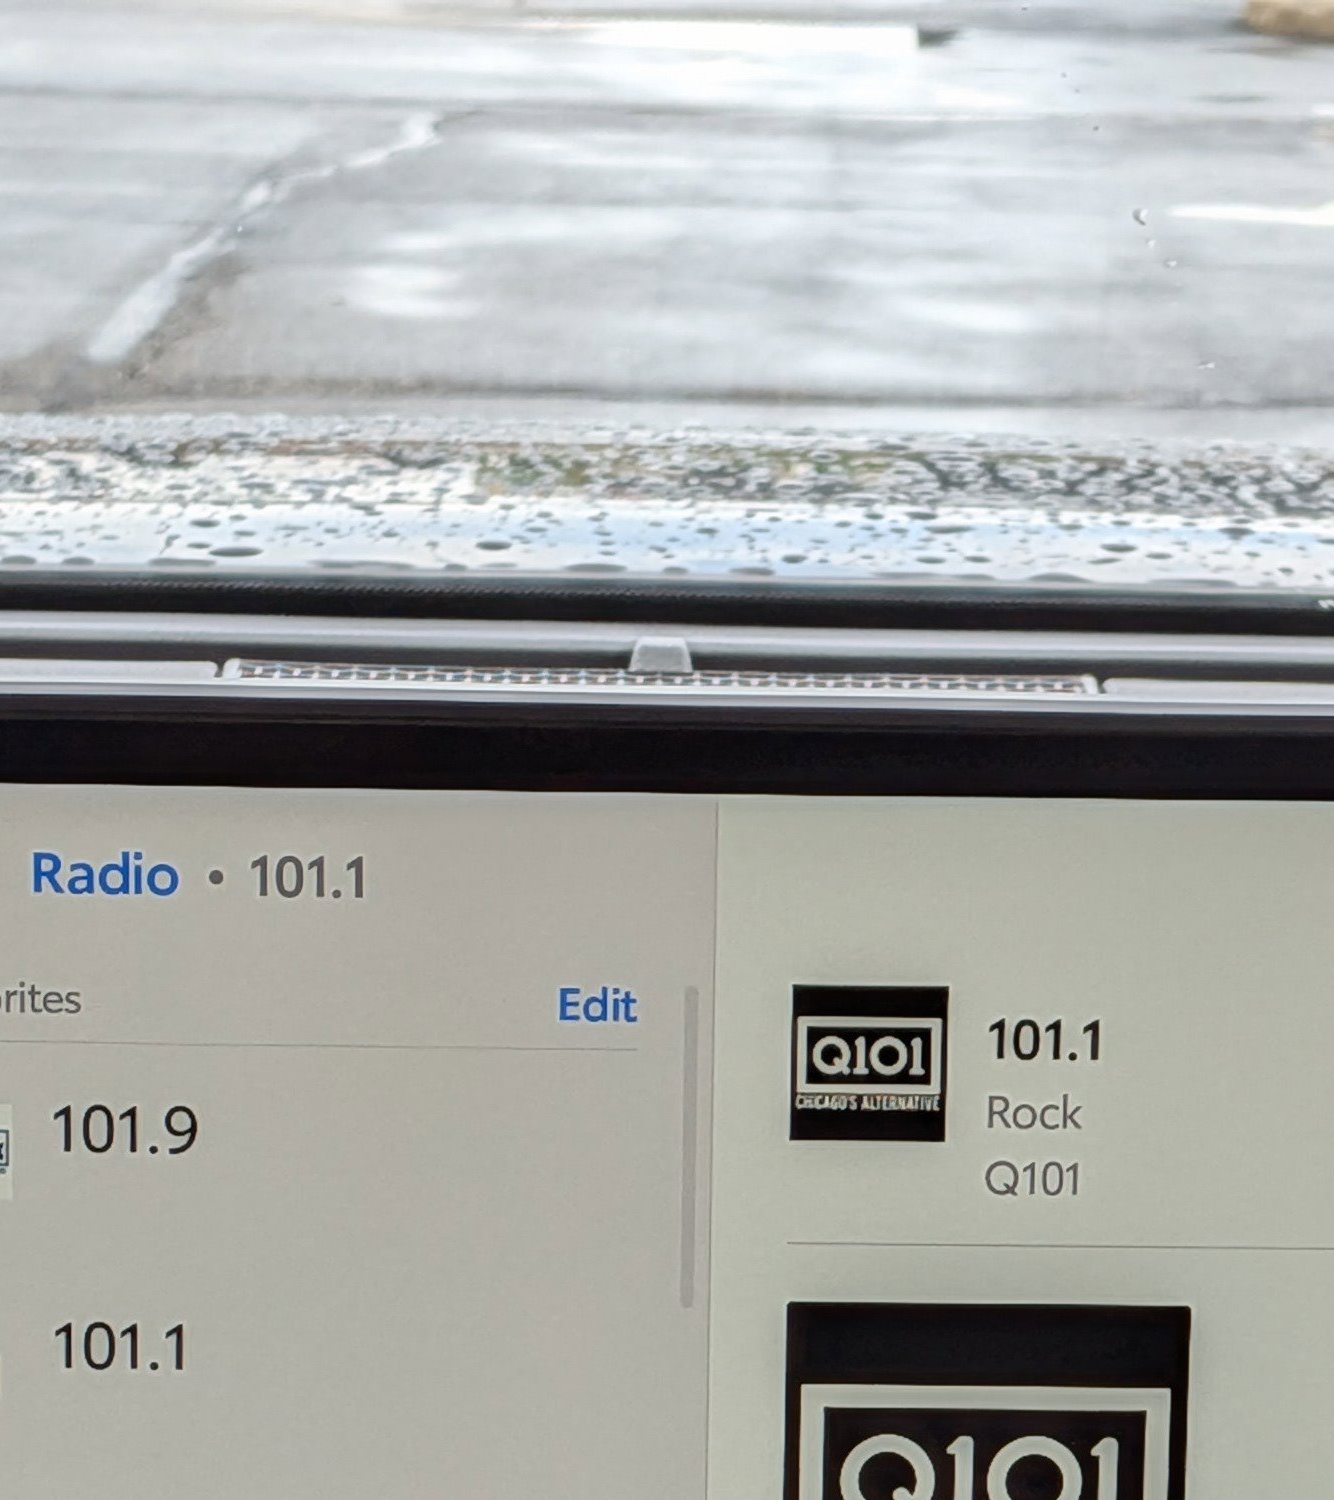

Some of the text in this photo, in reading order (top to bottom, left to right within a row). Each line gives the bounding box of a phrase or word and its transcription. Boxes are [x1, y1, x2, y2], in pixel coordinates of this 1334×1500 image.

[31, 851, 366, 900] Radio 101.1
[557, 986, 638, 1025] Edit
[811, 1035, 927, 1078] Q101
[988, 1018, 1103, 1062] 101.1
[52, 1104, 199, 1155] 101.9
[986, 1094, 1083, 1130] Rock
[984, 1160, 1081, 1197] Q101
[53, 1322, 188, 1371] 101.1
